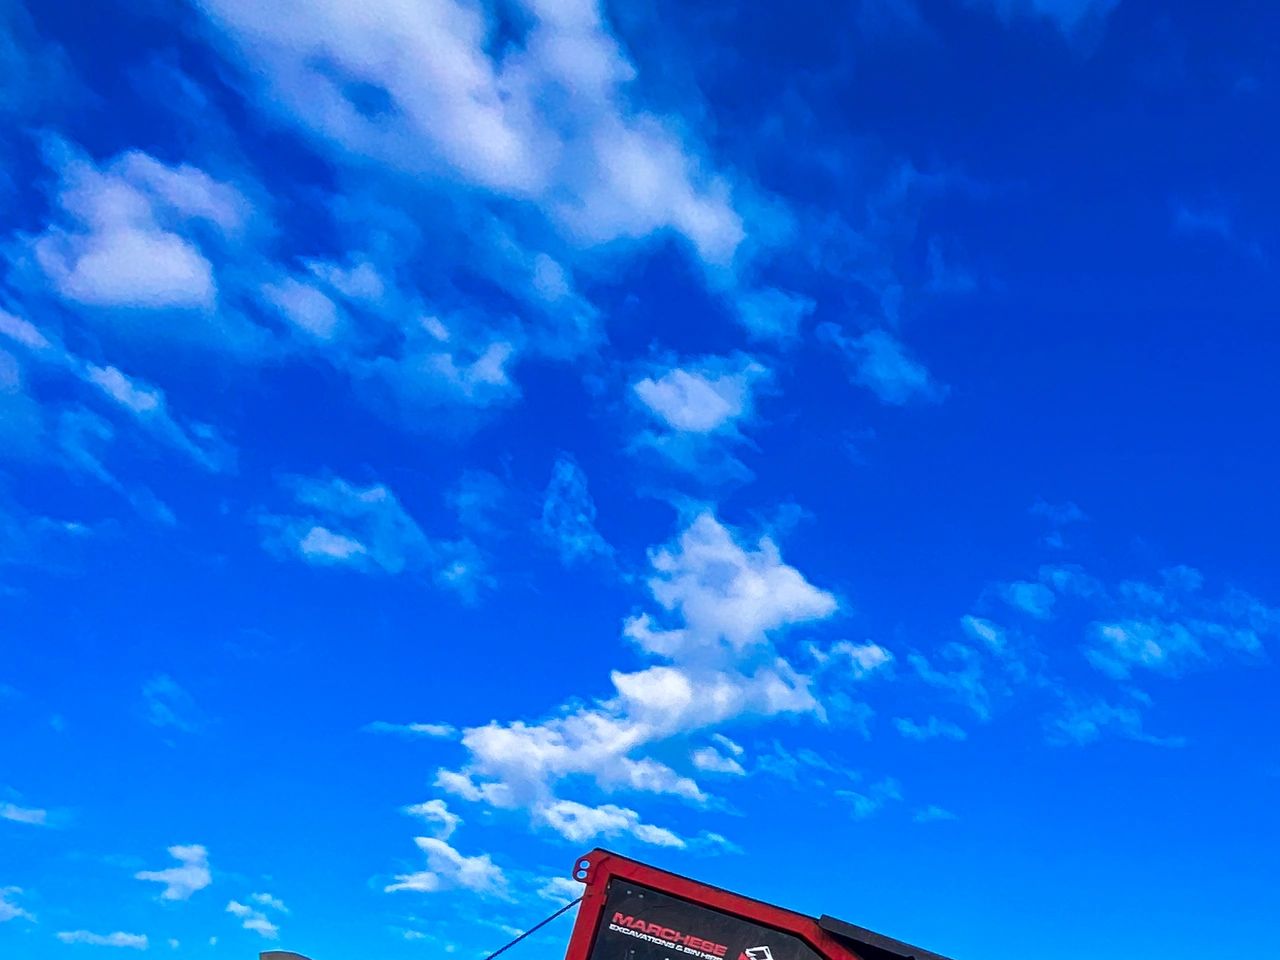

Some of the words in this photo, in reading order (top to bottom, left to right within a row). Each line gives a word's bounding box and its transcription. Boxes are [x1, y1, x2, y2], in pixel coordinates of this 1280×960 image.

[609, 923, 675, 949] EXCAVATIONS
[684, 947, 701, 957] BIN
[611, 911, 728, 957] MARCHESE
